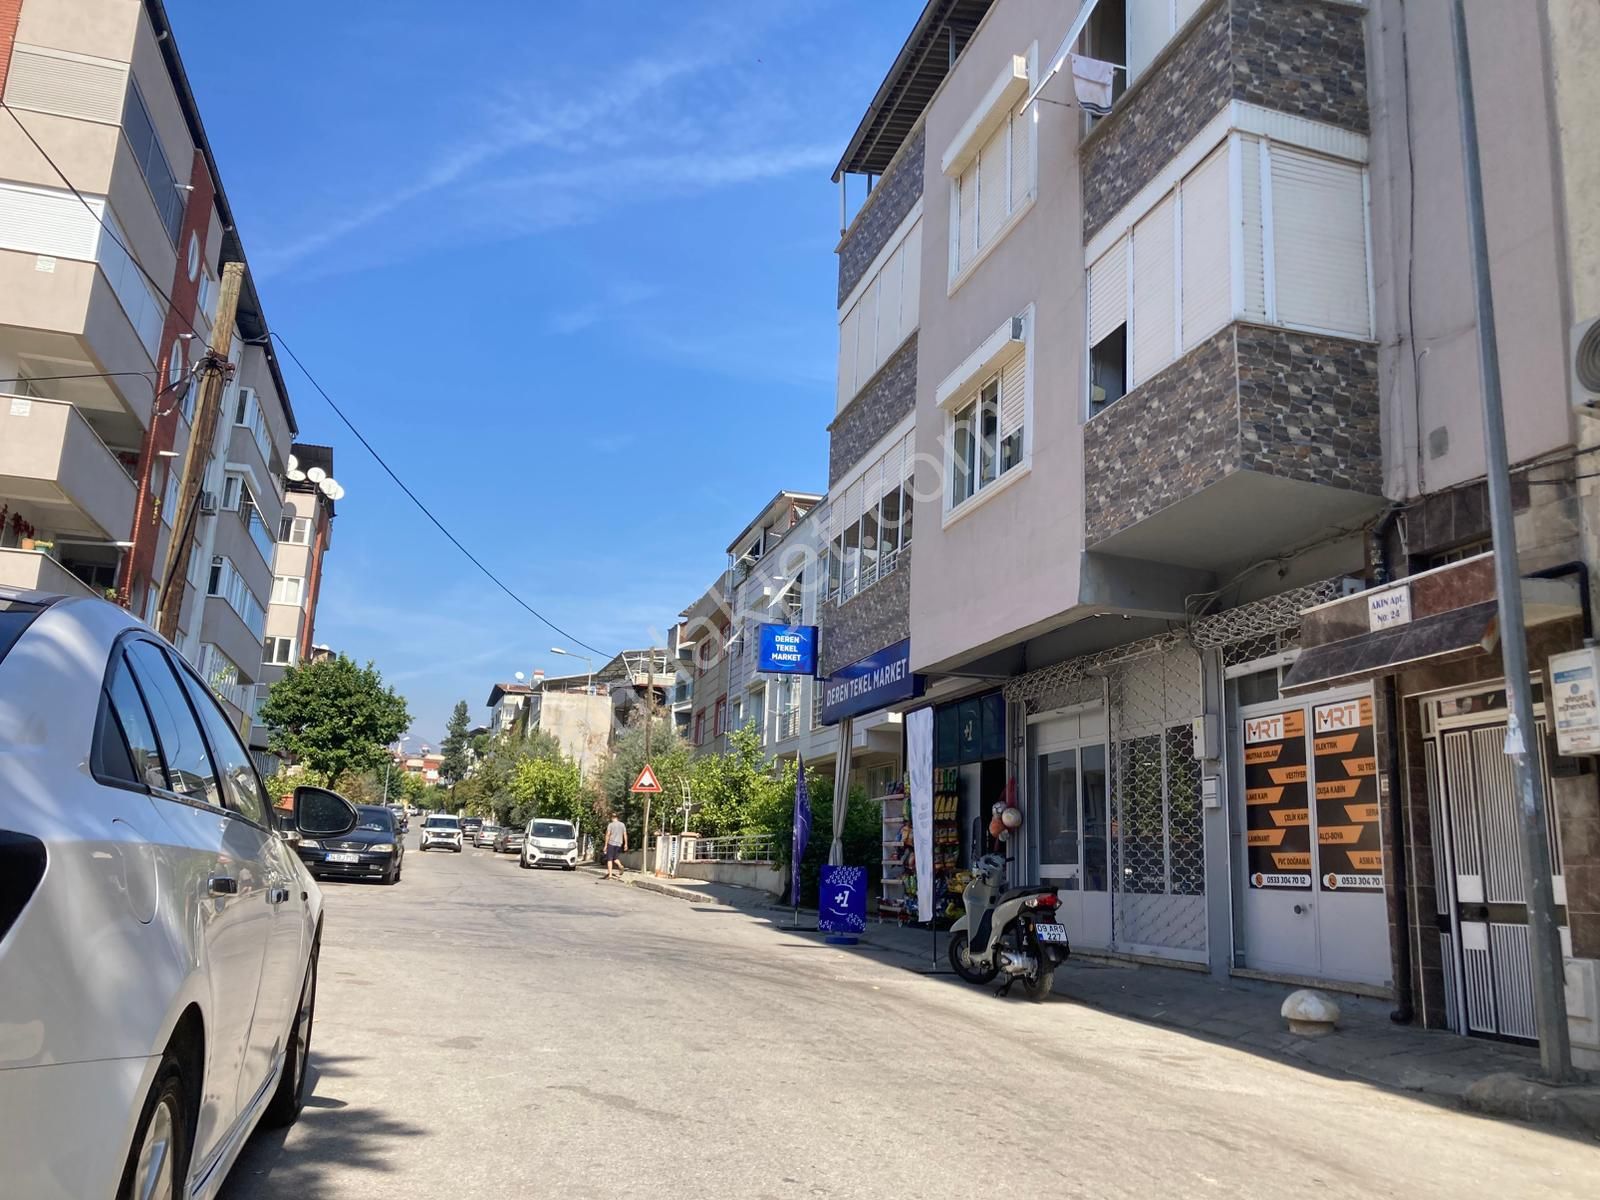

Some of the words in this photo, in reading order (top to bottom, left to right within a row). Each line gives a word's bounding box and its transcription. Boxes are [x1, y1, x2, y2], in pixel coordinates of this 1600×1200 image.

[1371, 598, 1389, 610] AKIN
[1390, 594, 1405, 606] Apt.
[1391, 610, 1400, 619] 24
[775, 635, 800, 643] DEREN
[776, 644, 798, 652] TEKEL
[826, 683, 849, 706] DEREN
[849, 672, 872, 698] TEKEL
[873, 658, 907, 689] MARKET
[1318, 704, 1356, 730] MRT
[1248, 718, 1280, 742] MRT
[1359, 856, 1374, 864] ASMA
[1358, 877, 1370, 885] 304
[1372, 877, 1380, 885] 70
[834, 890, 849, 907] +1
